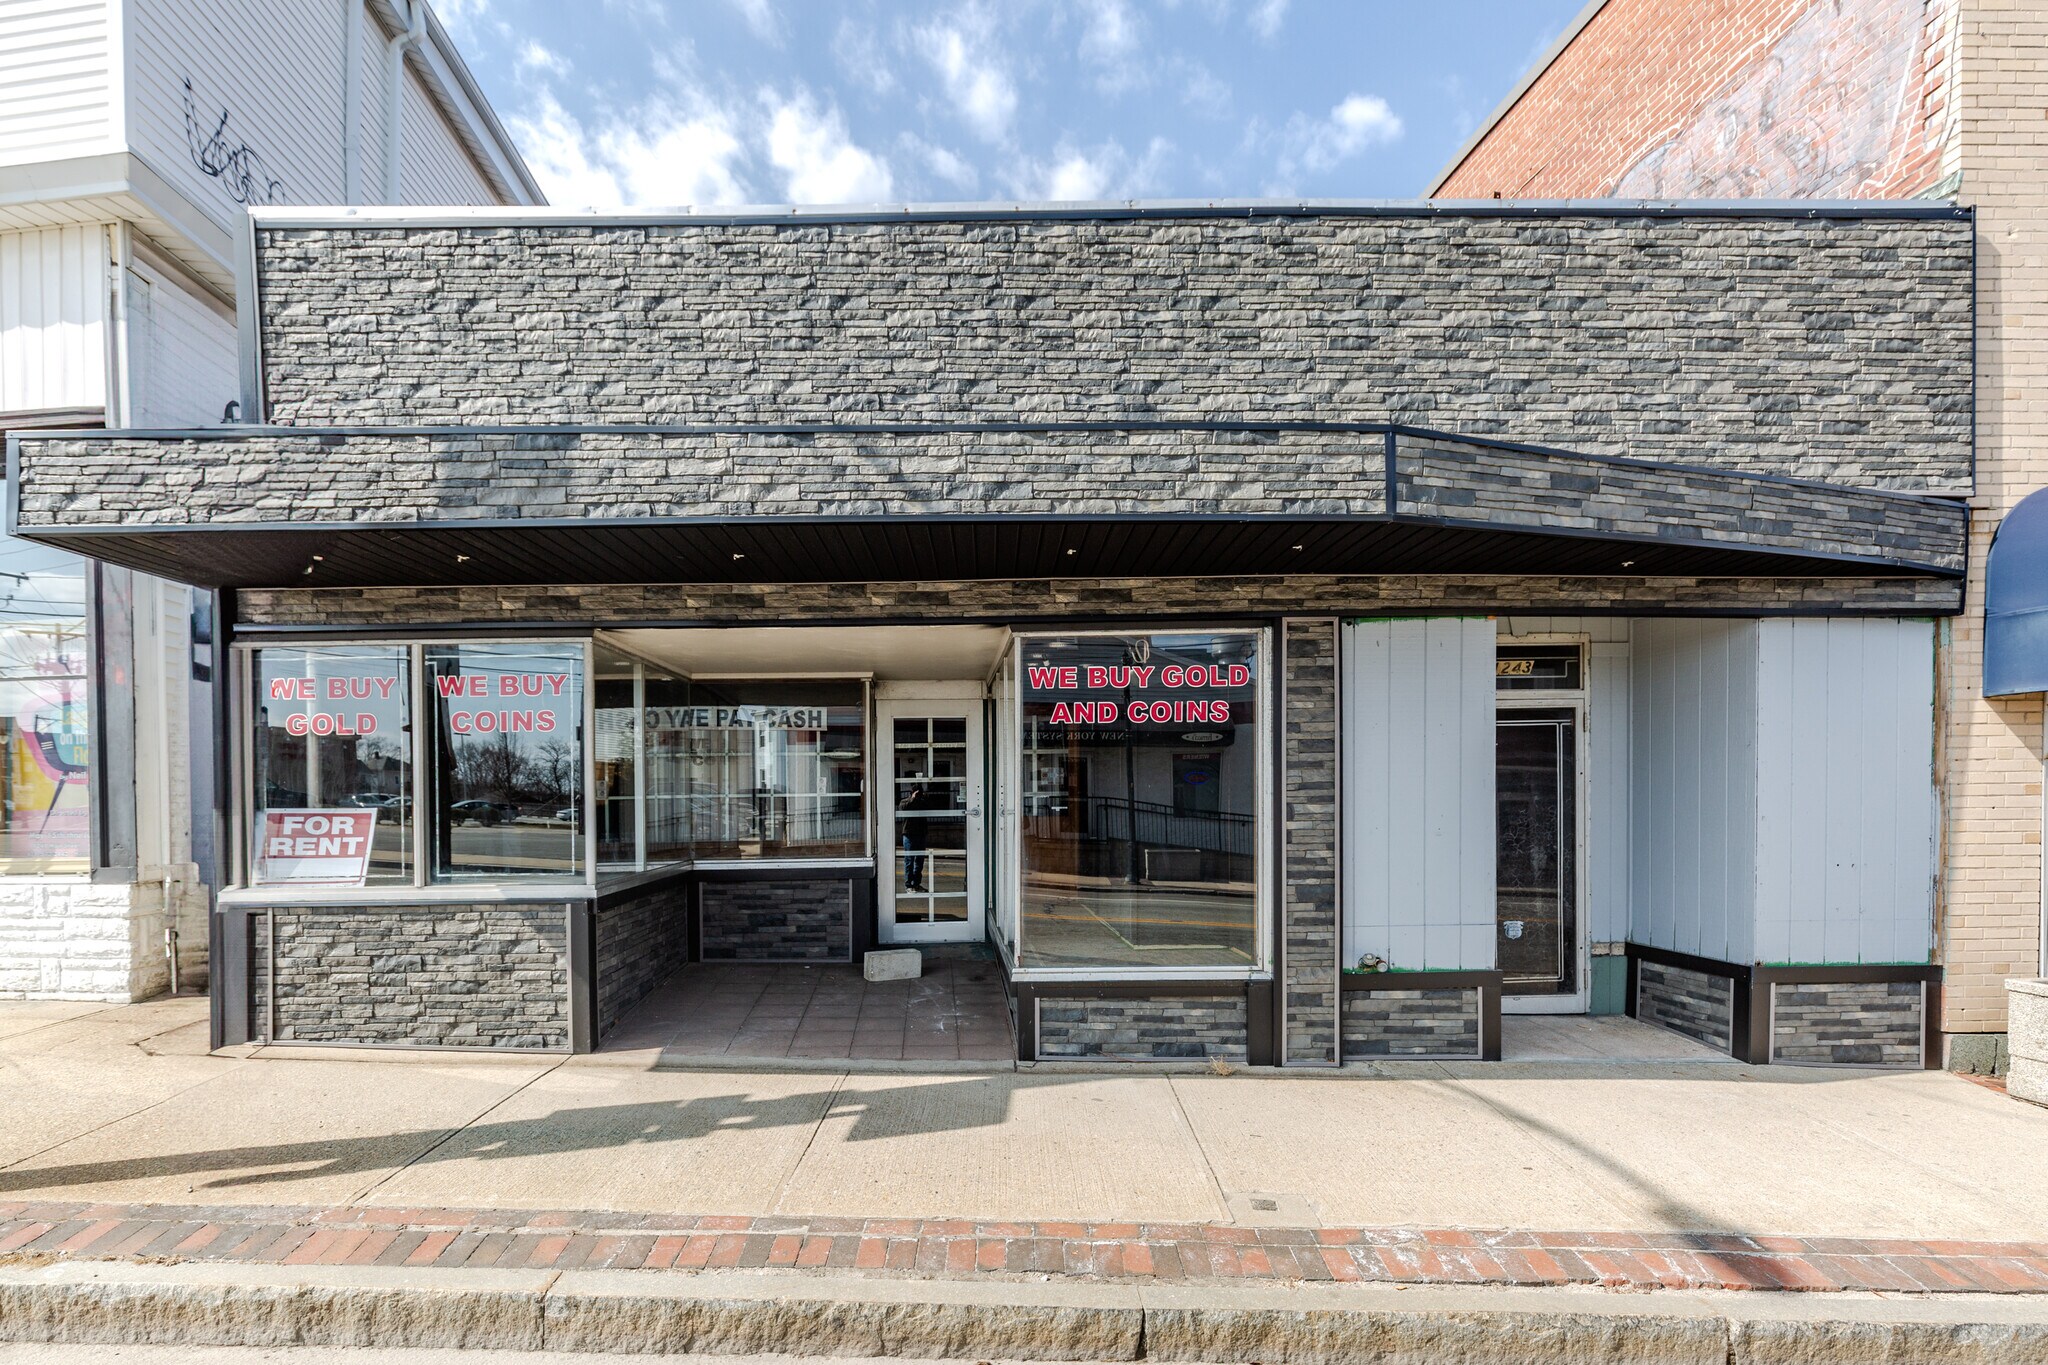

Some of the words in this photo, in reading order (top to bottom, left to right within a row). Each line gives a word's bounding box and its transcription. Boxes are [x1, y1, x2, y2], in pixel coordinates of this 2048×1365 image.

[271, 678, 316, 700] WE
[327, 677, 398, 699] BUY
[437, 676, 488, 697] WE
[499, 674, 568, 696] BUY
[1029, 667, 1078, 689] WE
[1087, 666, 1154, 688] BUY
[1161, 665, 1249, 688] GOLD
[451, 710, 556, 733] COINS
[765, 709, 822, 728] CASH
[1050, 702, 1118, 724] AND
[1127, 700, 1230, 723] COINS
[285, 713, 377, 736] GOLD
[283, 816, 355, 835] FOR
[269, 837, 364, 856] RENT
